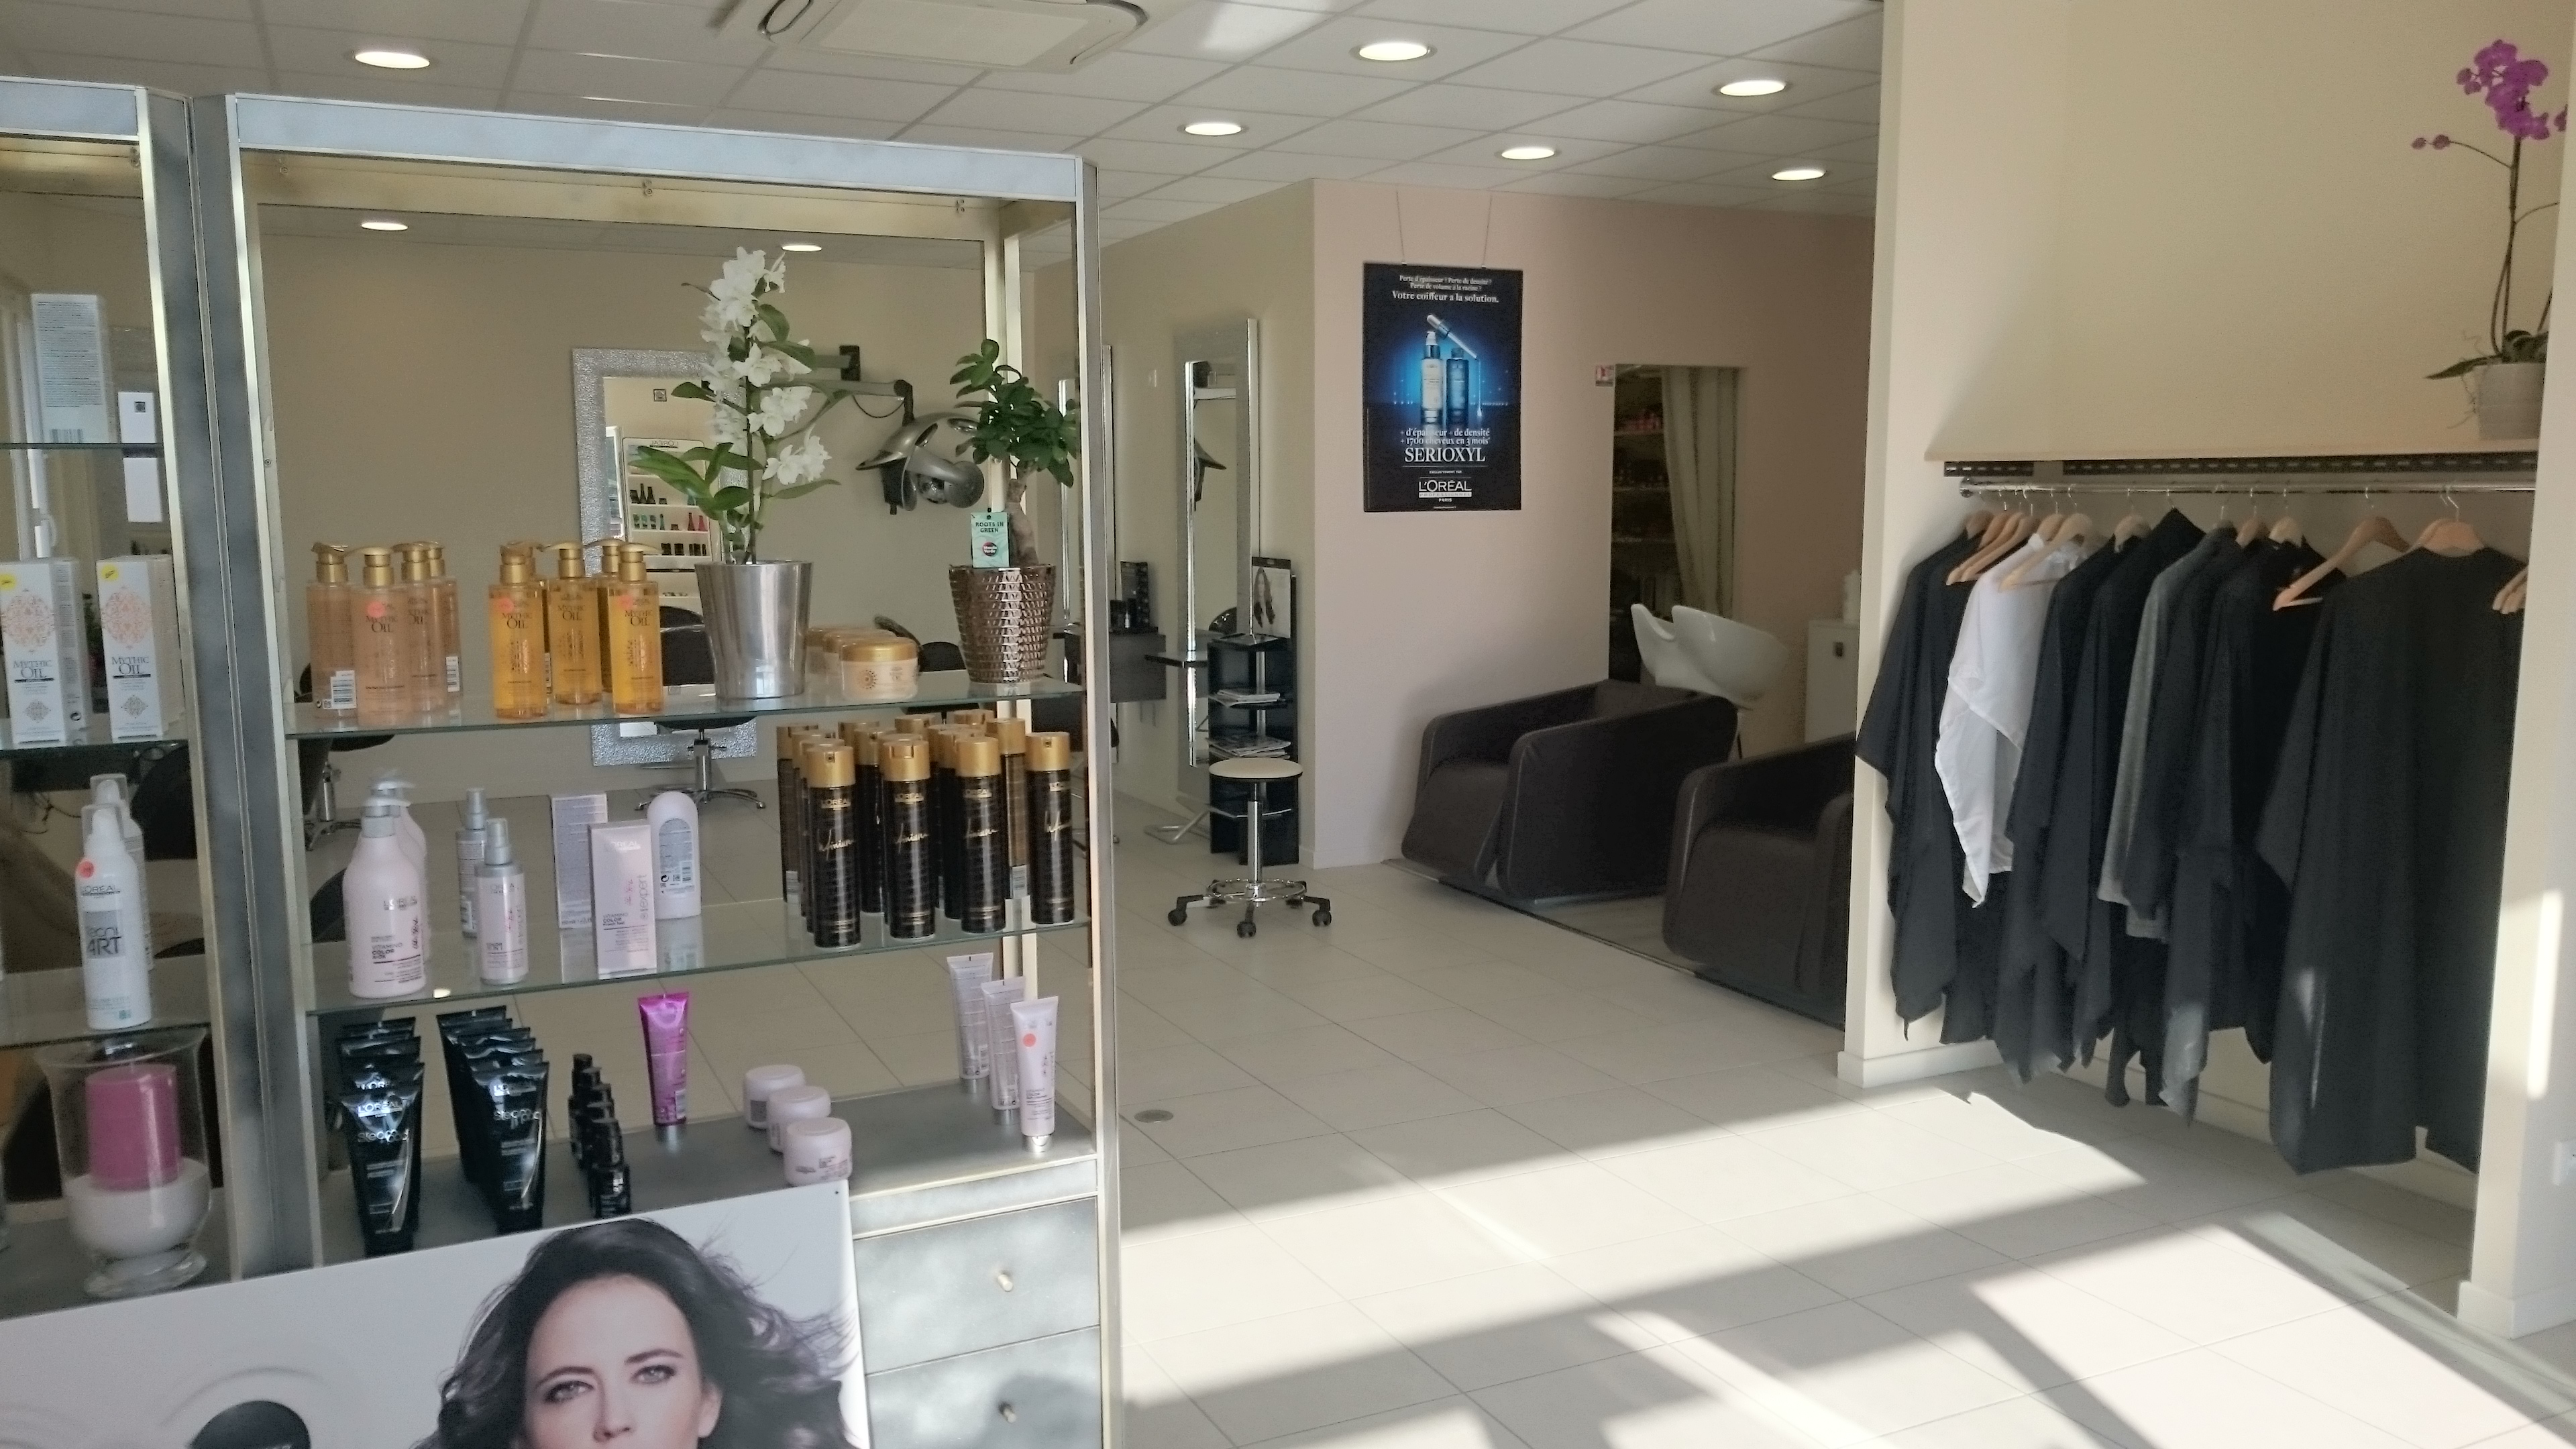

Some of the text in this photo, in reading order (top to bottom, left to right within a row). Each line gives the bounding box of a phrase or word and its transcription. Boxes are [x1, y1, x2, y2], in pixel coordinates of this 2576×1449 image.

[1392, 290, 1415, 299] Votre
[1416, 292, 1448, 301] coiffeur
[1455, 293, 1463, 301] la
[1464, 294, 1499, 303] solution.
[1406, 428, 1447, 438] d'épaeur
[1454, 429, 1463, 437] de
[1464, 428, 1490, 437] densité
[1405, 447, 1486, 462] SERIOXYL
[1419, 480, 1472, 492] L'ORÉAL
[13, 660, 52, 668] MYTHIC
[119, 663, 144, 674] OIL
[21, 667, 47, 678] OIL
[88, 936, 121, 955] ART
